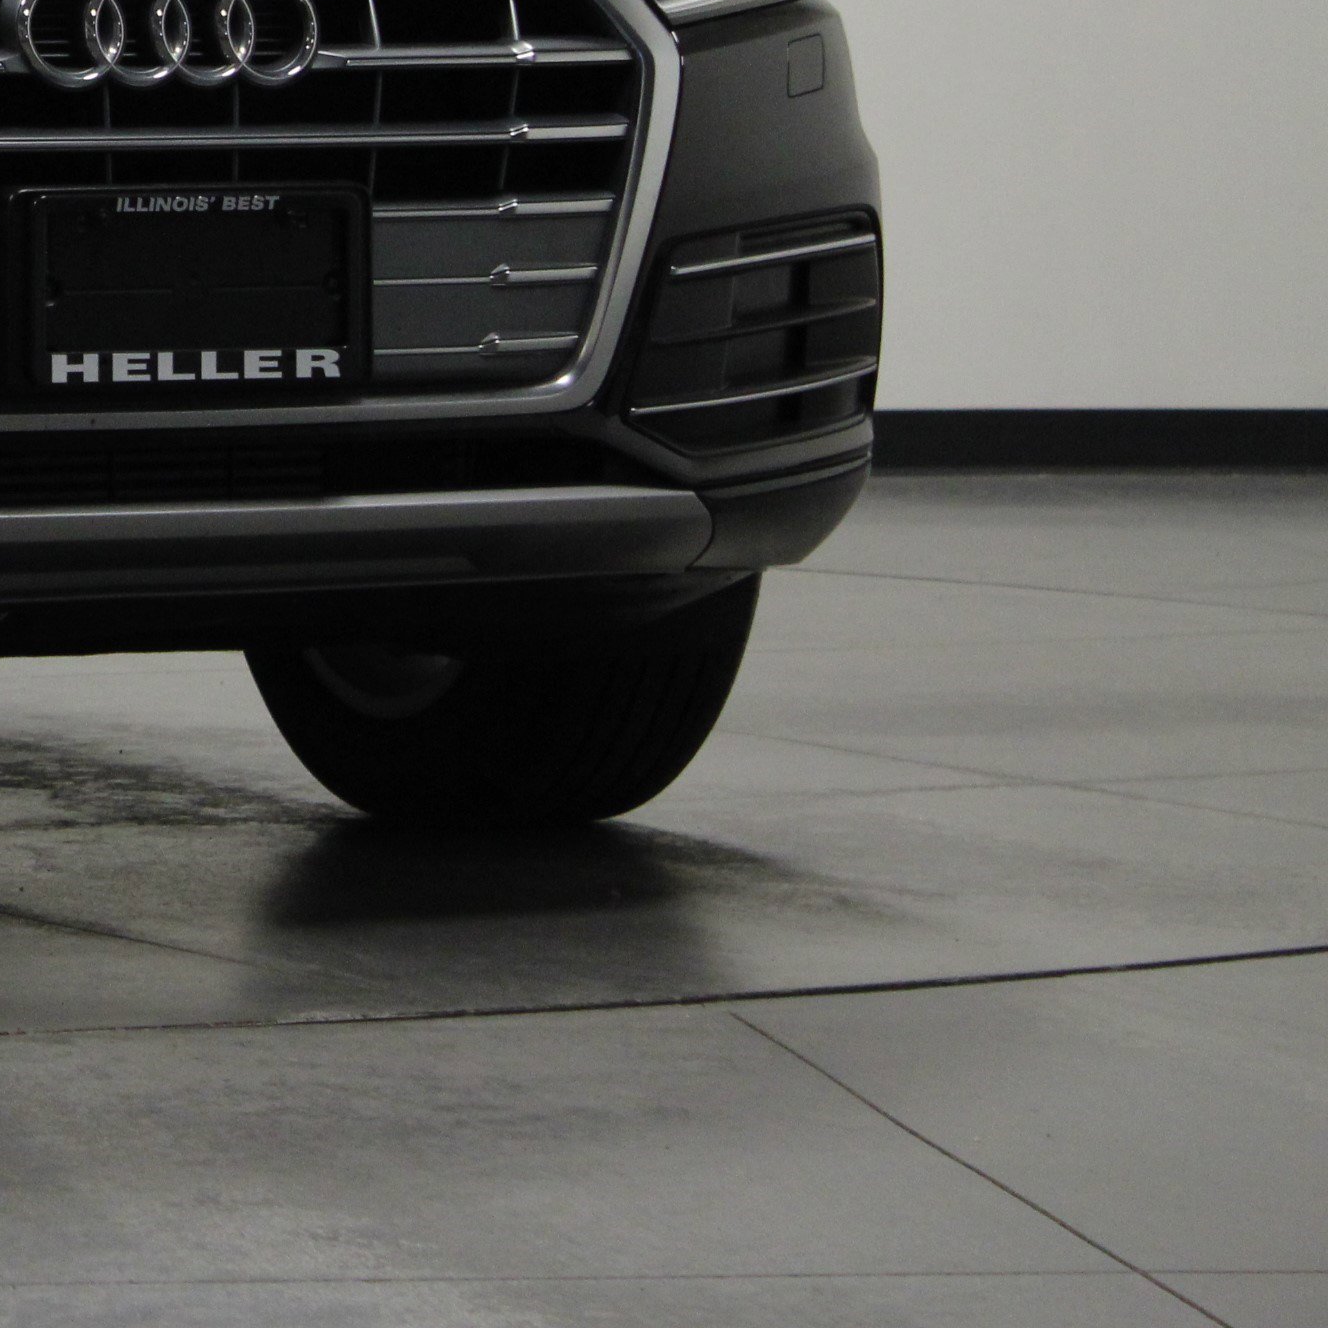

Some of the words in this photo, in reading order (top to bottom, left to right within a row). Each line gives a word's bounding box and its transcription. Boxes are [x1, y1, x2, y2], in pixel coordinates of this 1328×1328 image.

[116, 195, 217, 213] ILLINOIS'
[221, 194, 280, 212] BEST
[50, 348, 342, 384] HELLER
